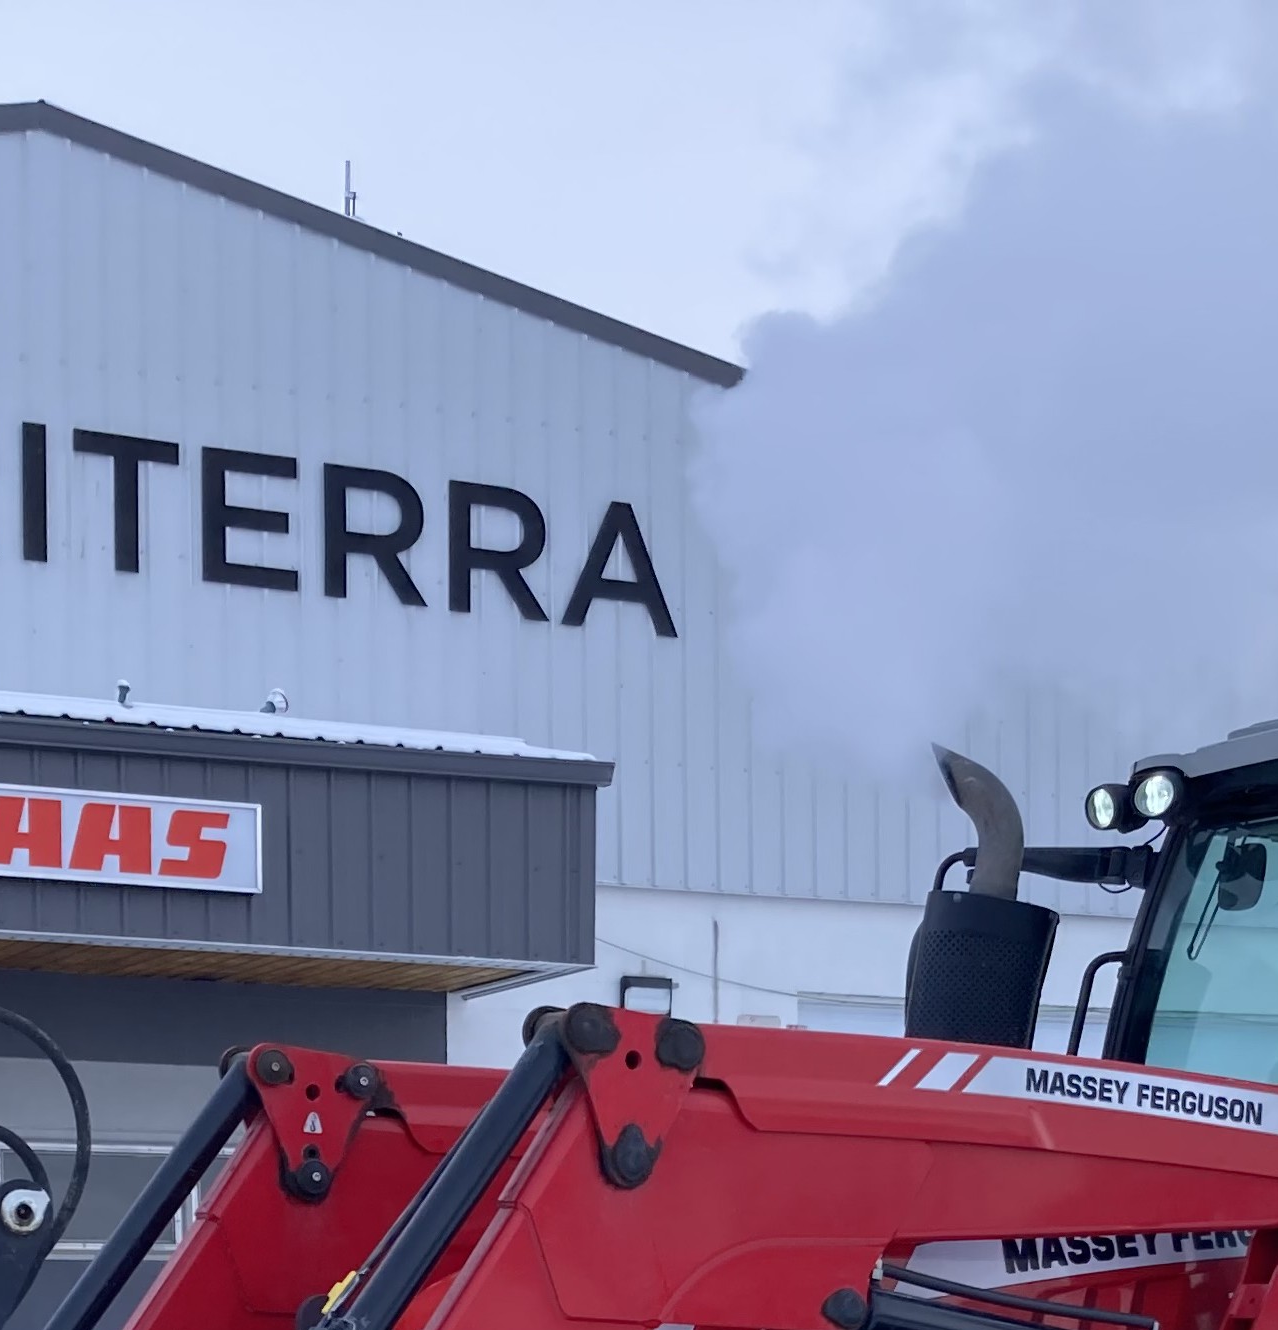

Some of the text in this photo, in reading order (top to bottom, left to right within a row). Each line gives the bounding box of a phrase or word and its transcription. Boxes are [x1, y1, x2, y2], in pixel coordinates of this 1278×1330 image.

[1025, 1067, 1263, 1126] MASSEY FERGUSON
[1002, 1233, 1157, 1274] MASSEY
